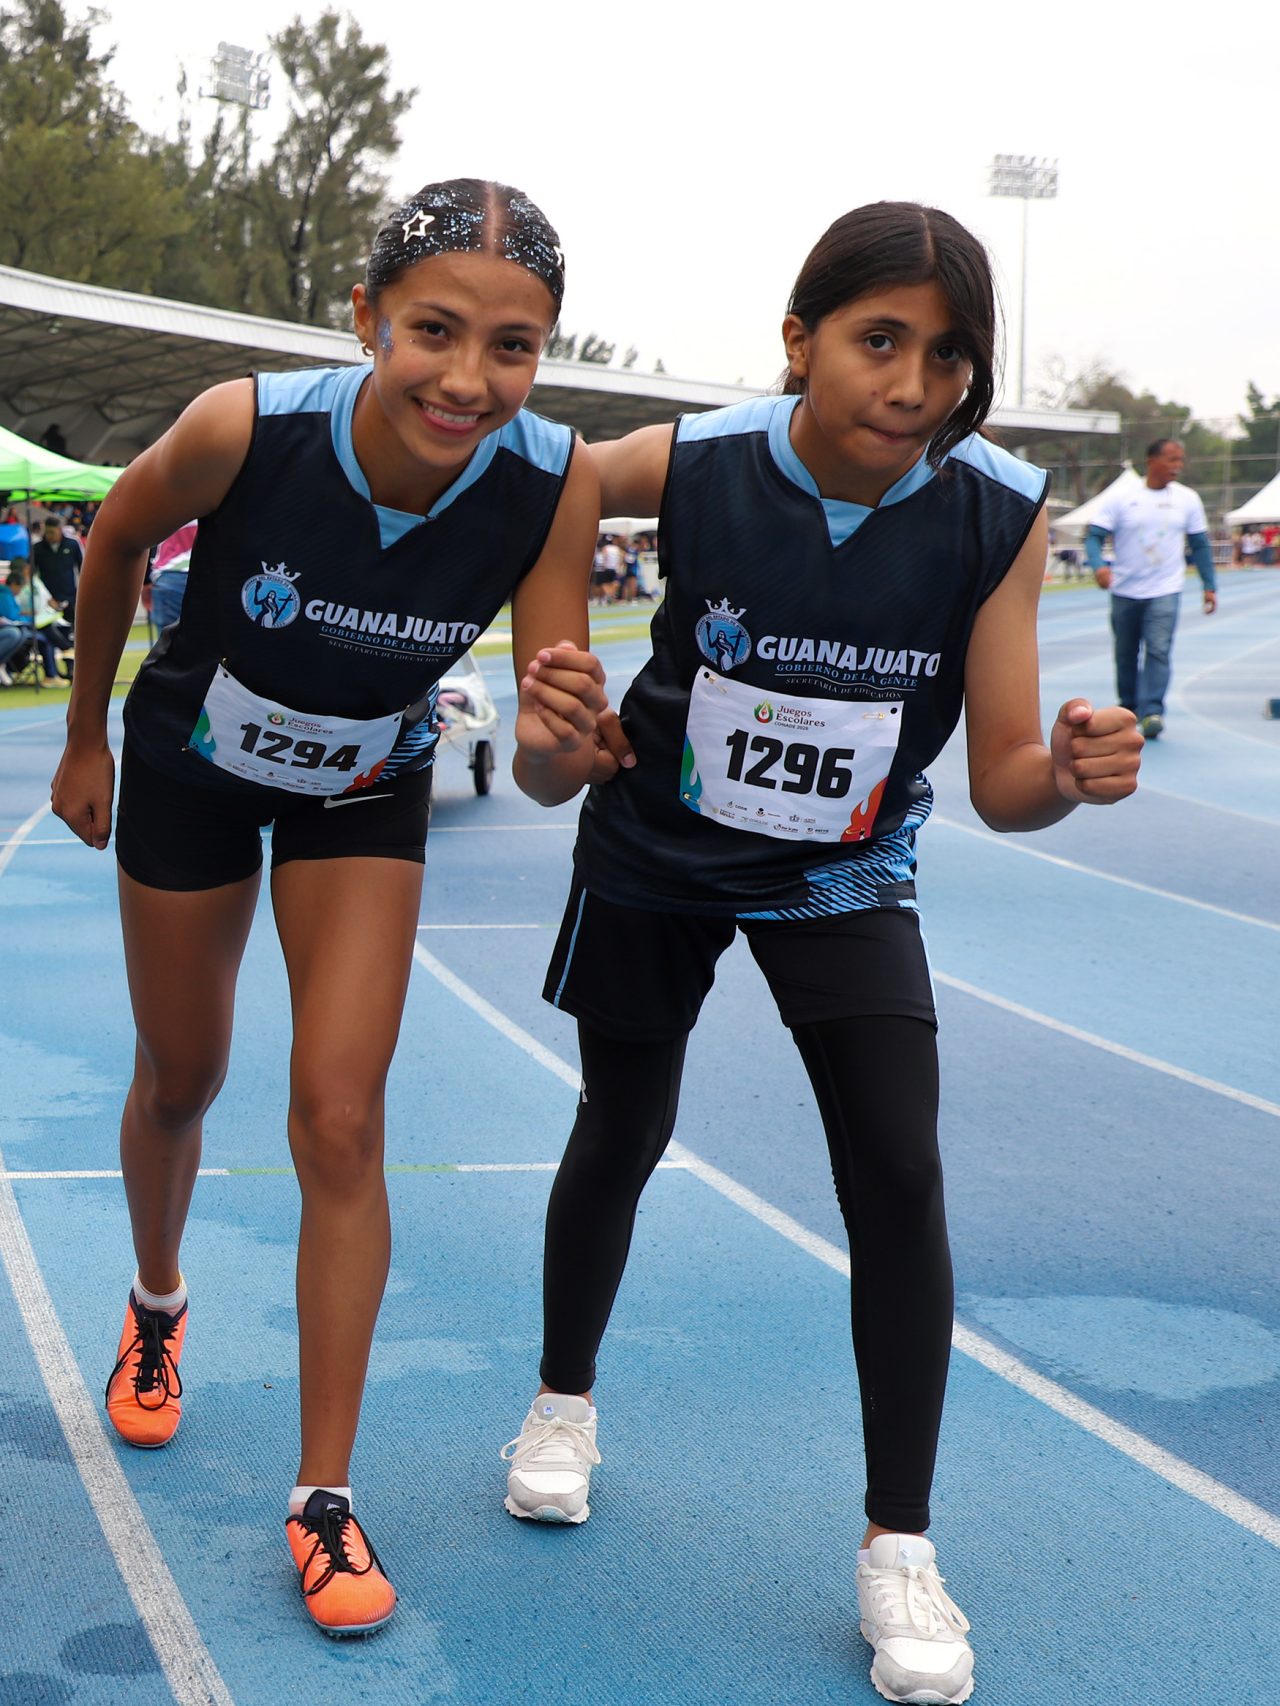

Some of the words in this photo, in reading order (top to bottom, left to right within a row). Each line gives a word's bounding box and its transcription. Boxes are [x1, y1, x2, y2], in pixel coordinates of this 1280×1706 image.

[304, 599, 481, 645] GUANAJUATO
[321, 625, 381, 645] GOBIERNO
[383, 639, 398, 648] DE
[401, 642, 415, 651] LA
[419, 644, 455, 654] GENTE
[756, 635, 942, 678] GUANAJUATO
[776, 663, 840, 679] GOBIERNO
[842, 672, 858, 681] DE
[861, 673, 876, 683] LA
[880, 677, 918, 687] GENTE
[776, 712, 826, 728] Escolares
[777, 705, 812, 718] Juegos
[240, 722, 361, 772] 1294
[725, 728, 856, 799] 1296
